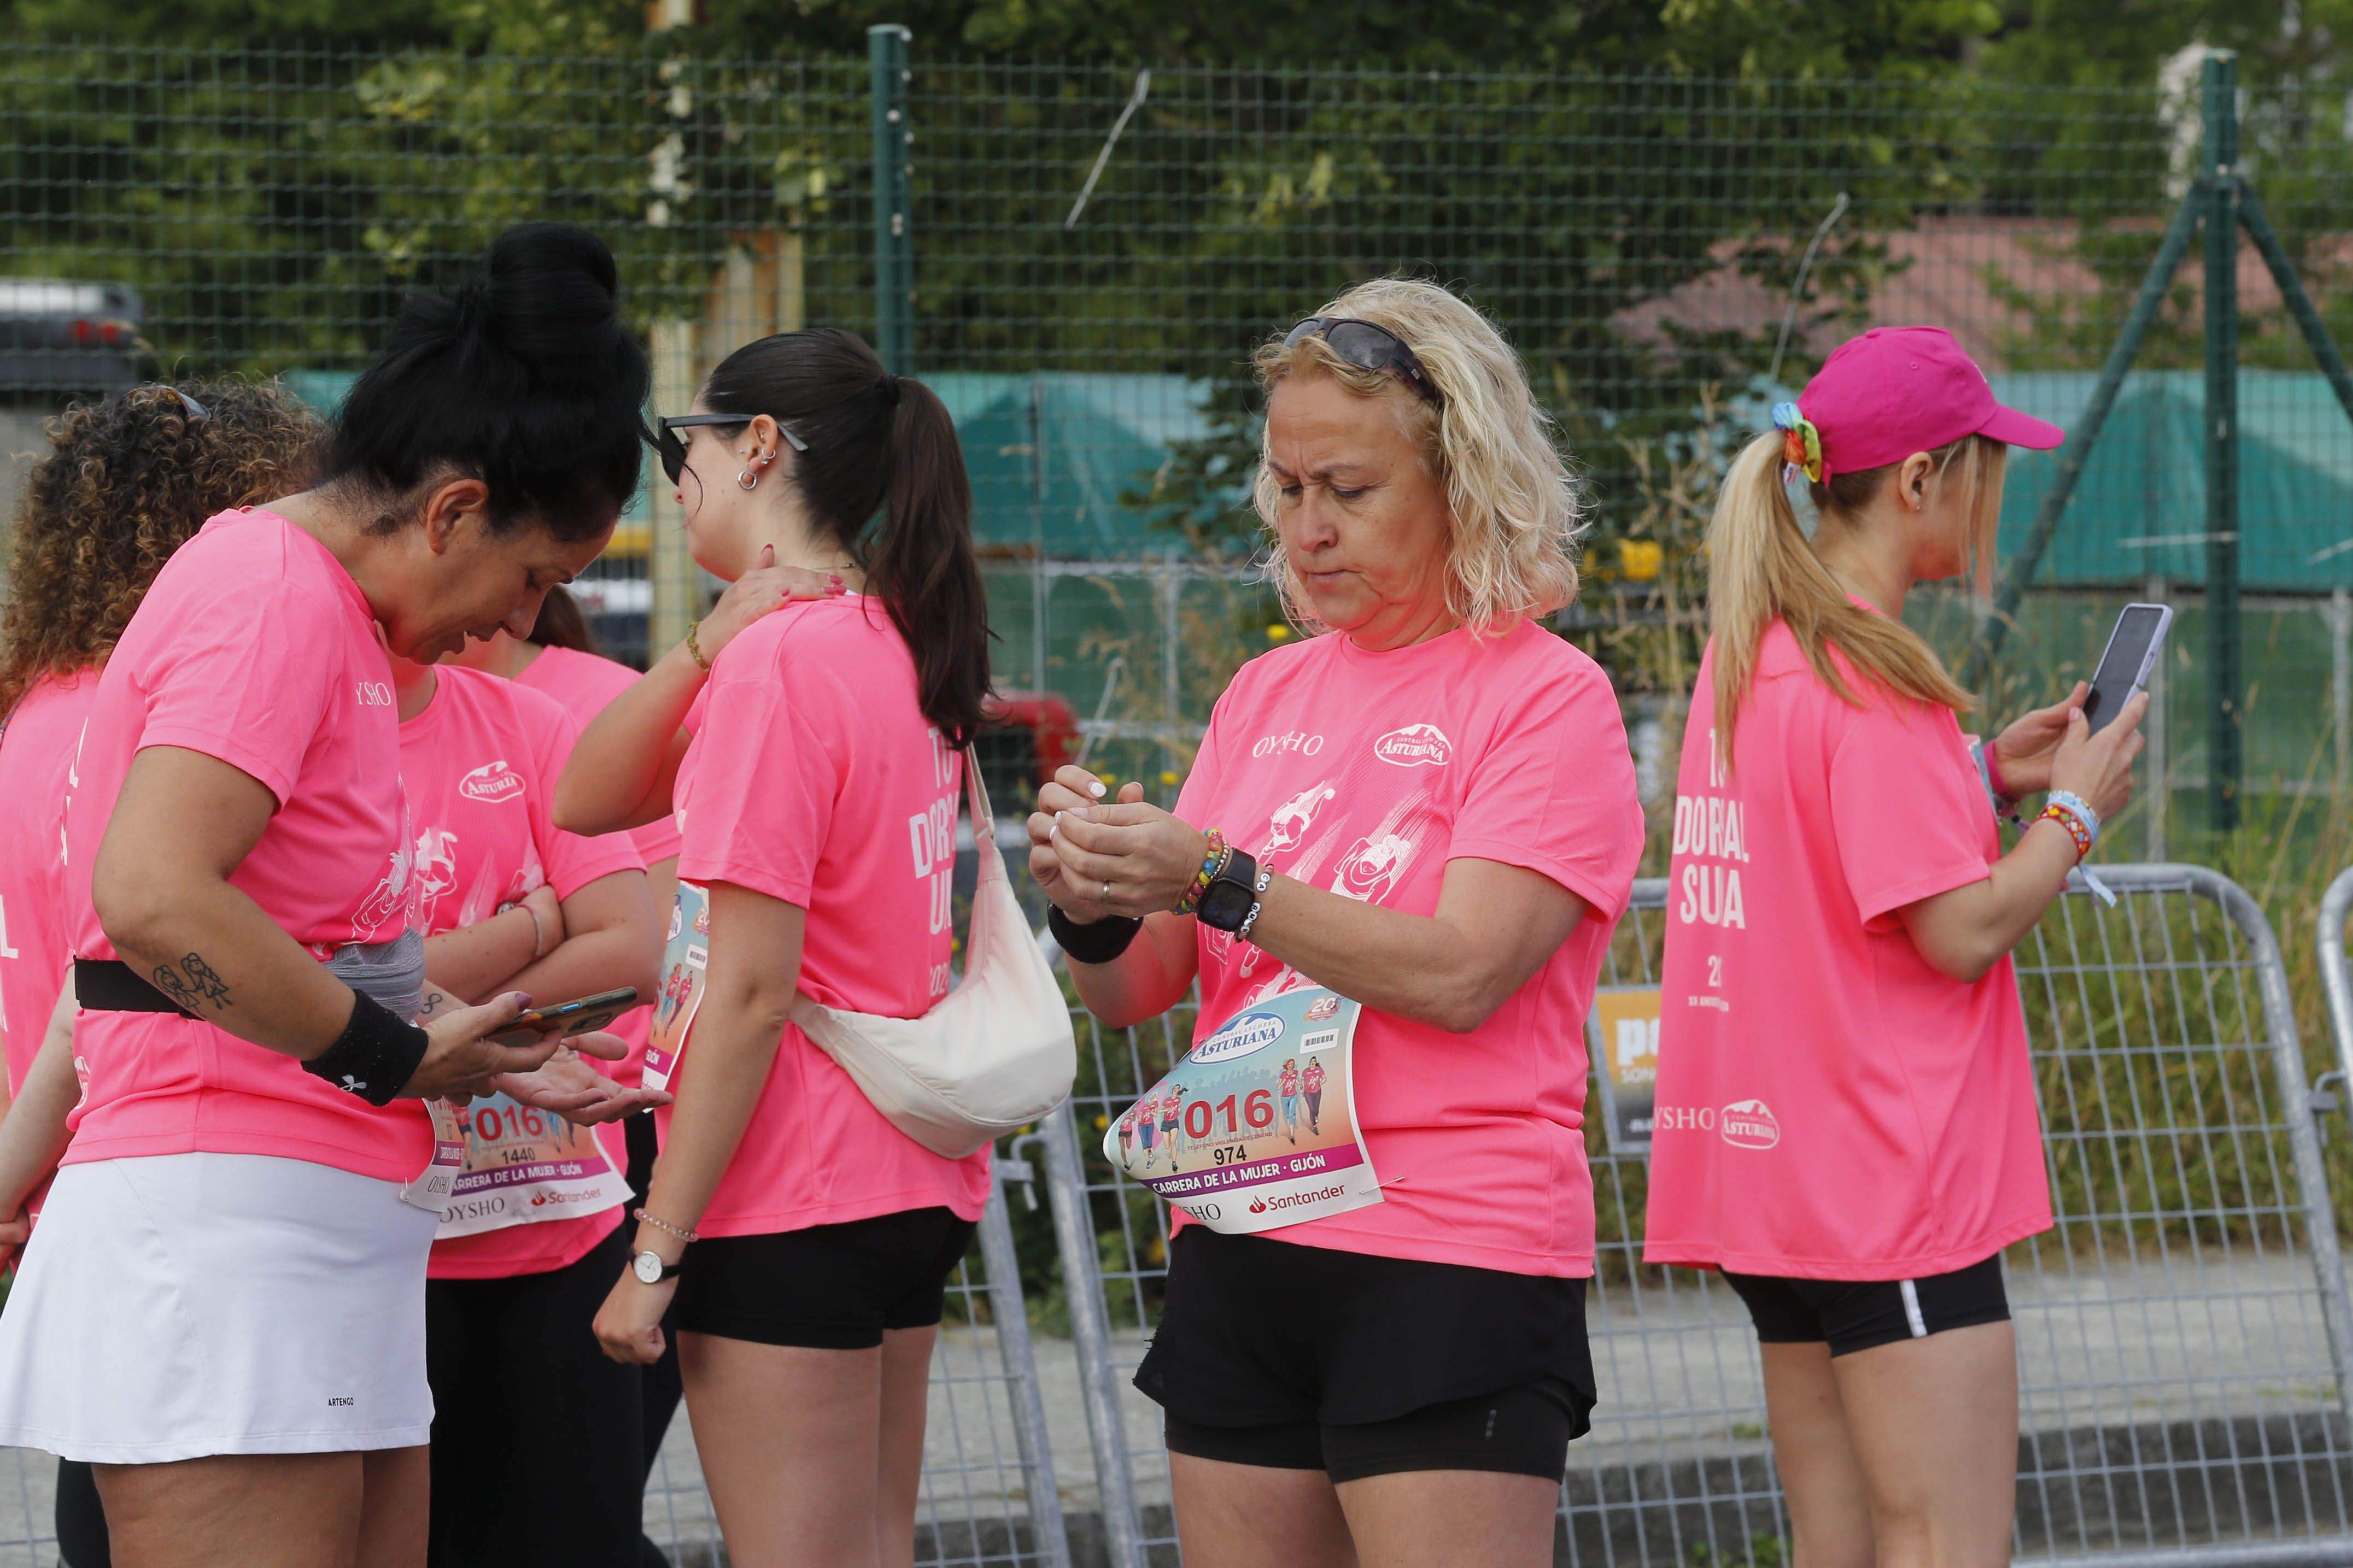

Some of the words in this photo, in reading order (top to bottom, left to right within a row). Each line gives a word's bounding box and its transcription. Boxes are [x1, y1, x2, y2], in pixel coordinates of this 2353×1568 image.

[356, 682, 391, 706] YSHO
[1311, 997, 1336, 1013] 20
[1244, 1020, 1276, 1033] LECHERA
[1194, 1027, 1277, 1060] ASTURIANA
[476, 1104, 543, 1141] 016
[1184, 1089, 1274, 1139] 016
[501, 1147, 536, 1165] 1440
[1214, 1144, 1247, 1166] 974
[452, 1173, 492, 1191] ARRERA
[494, 1171, 509, 1184] DE
[512, 1168, 526, 1181] LA
[1152, 1176, 1203, 1194] CARRERA
[1204, 1173, 1220, 1188] DE
[1222, 1169, 1238, 1184] LA
[1240, 1163, 1281, 1182] MUJER
[1289, 1153, 1326, 1172] GIJÓN
[1268, 1185, 1345, 1211] Santander
[328, 1397, 354, 1407] ARTENGO
